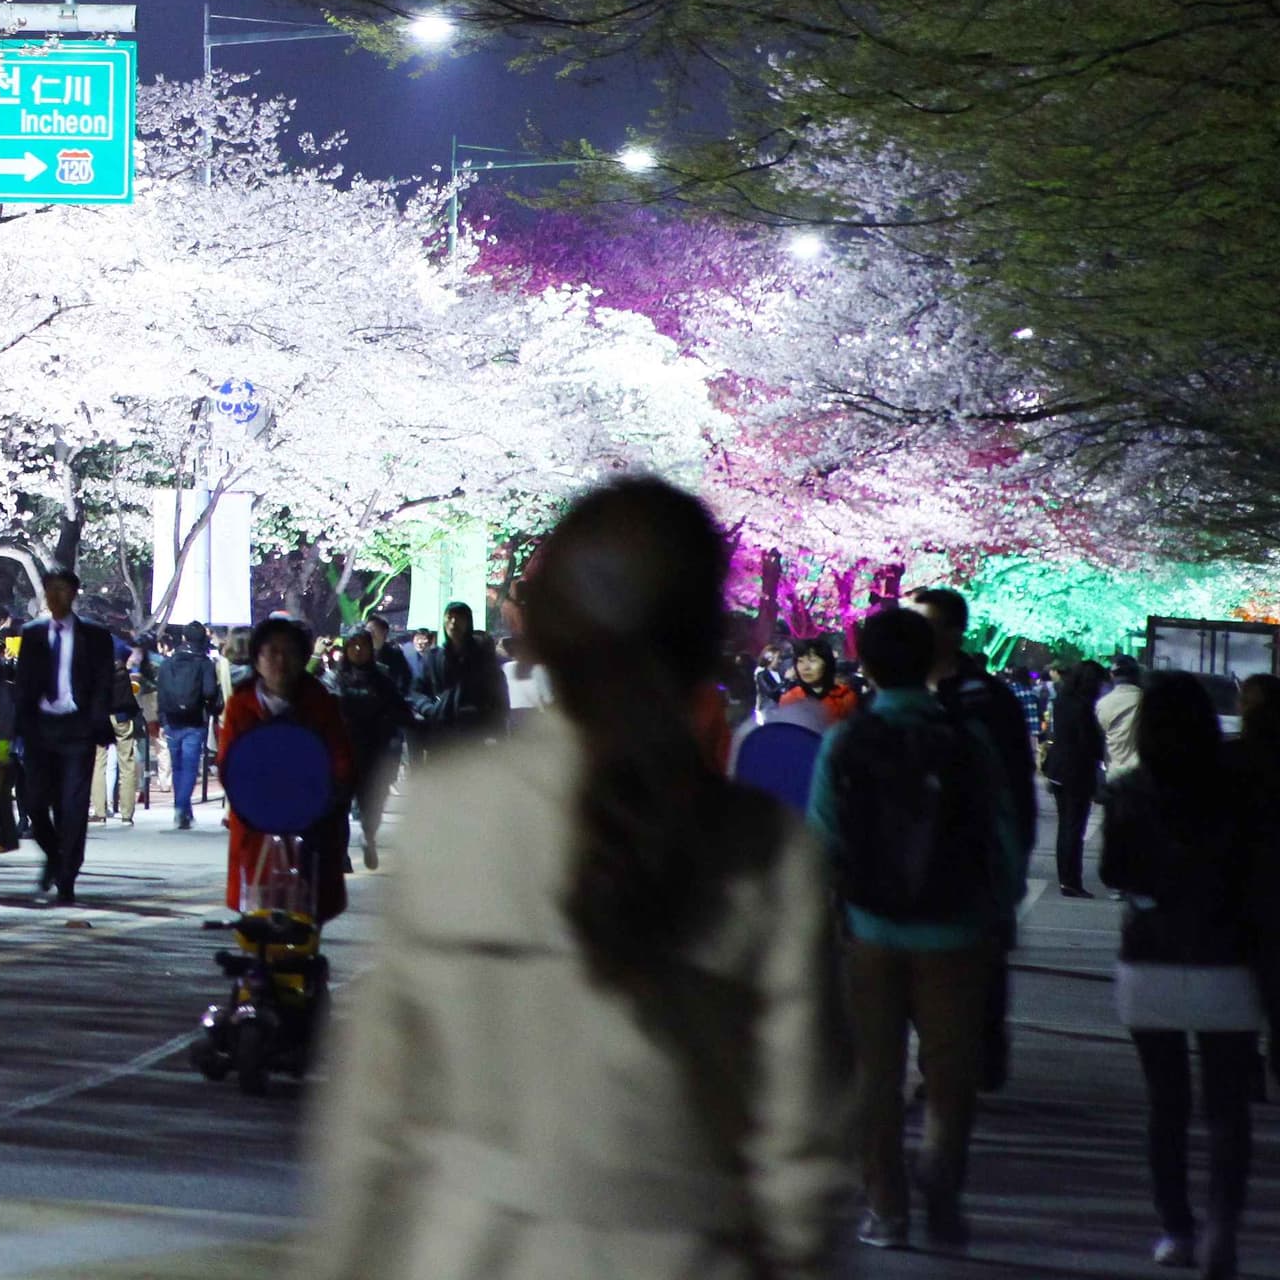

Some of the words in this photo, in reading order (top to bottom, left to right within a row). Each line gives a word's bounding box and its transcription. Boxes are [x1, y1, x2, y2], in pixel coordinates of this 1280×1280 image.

[31, 74, 91, 106] 仁川
[20, 108, 108, 134] Incheon
[59, 160, 90, 182] 120
